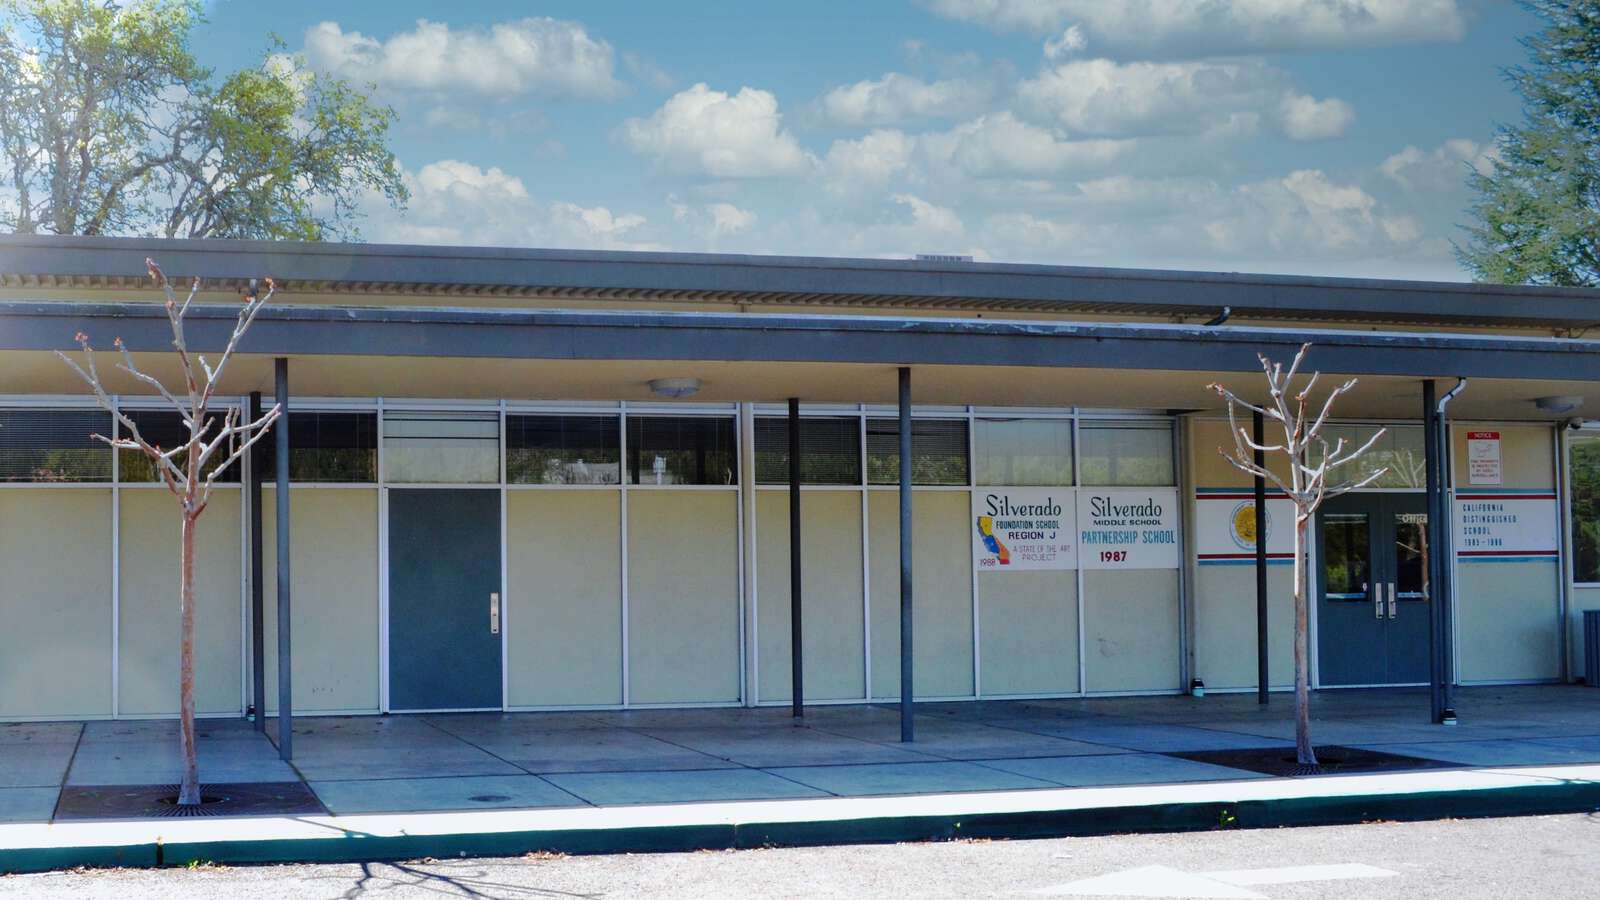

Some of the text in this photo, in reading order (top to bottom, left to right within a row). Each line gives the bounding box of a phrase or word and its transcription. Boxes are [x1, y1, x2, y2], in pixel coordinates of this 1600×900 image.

[986, 494, 1062, 517] Silverado
[1090, 496, 1162, 517] Silverado
[1463, 503, 1504, 512] CALIFORNIA
[1463, 514, 1516, 523] DISTINGUISHED
[996, 520, 1060, 529] FOUNDATION SCHOOL
[1463, 526, 1491, 535] SCHOOL
[1008, 531, 1056, 540] REGION J
[1081, 530, 1176, 544] PARTNERSHIP SCHOOL
[1019, 544, 1036, 553] STATE
[1045, 544, 1057, 552] THE
[1060, 544, 1071, 552] ART
[1022, 553, 1057, 561] PROJECT
[1100, 551, 1127, 562] 1987
